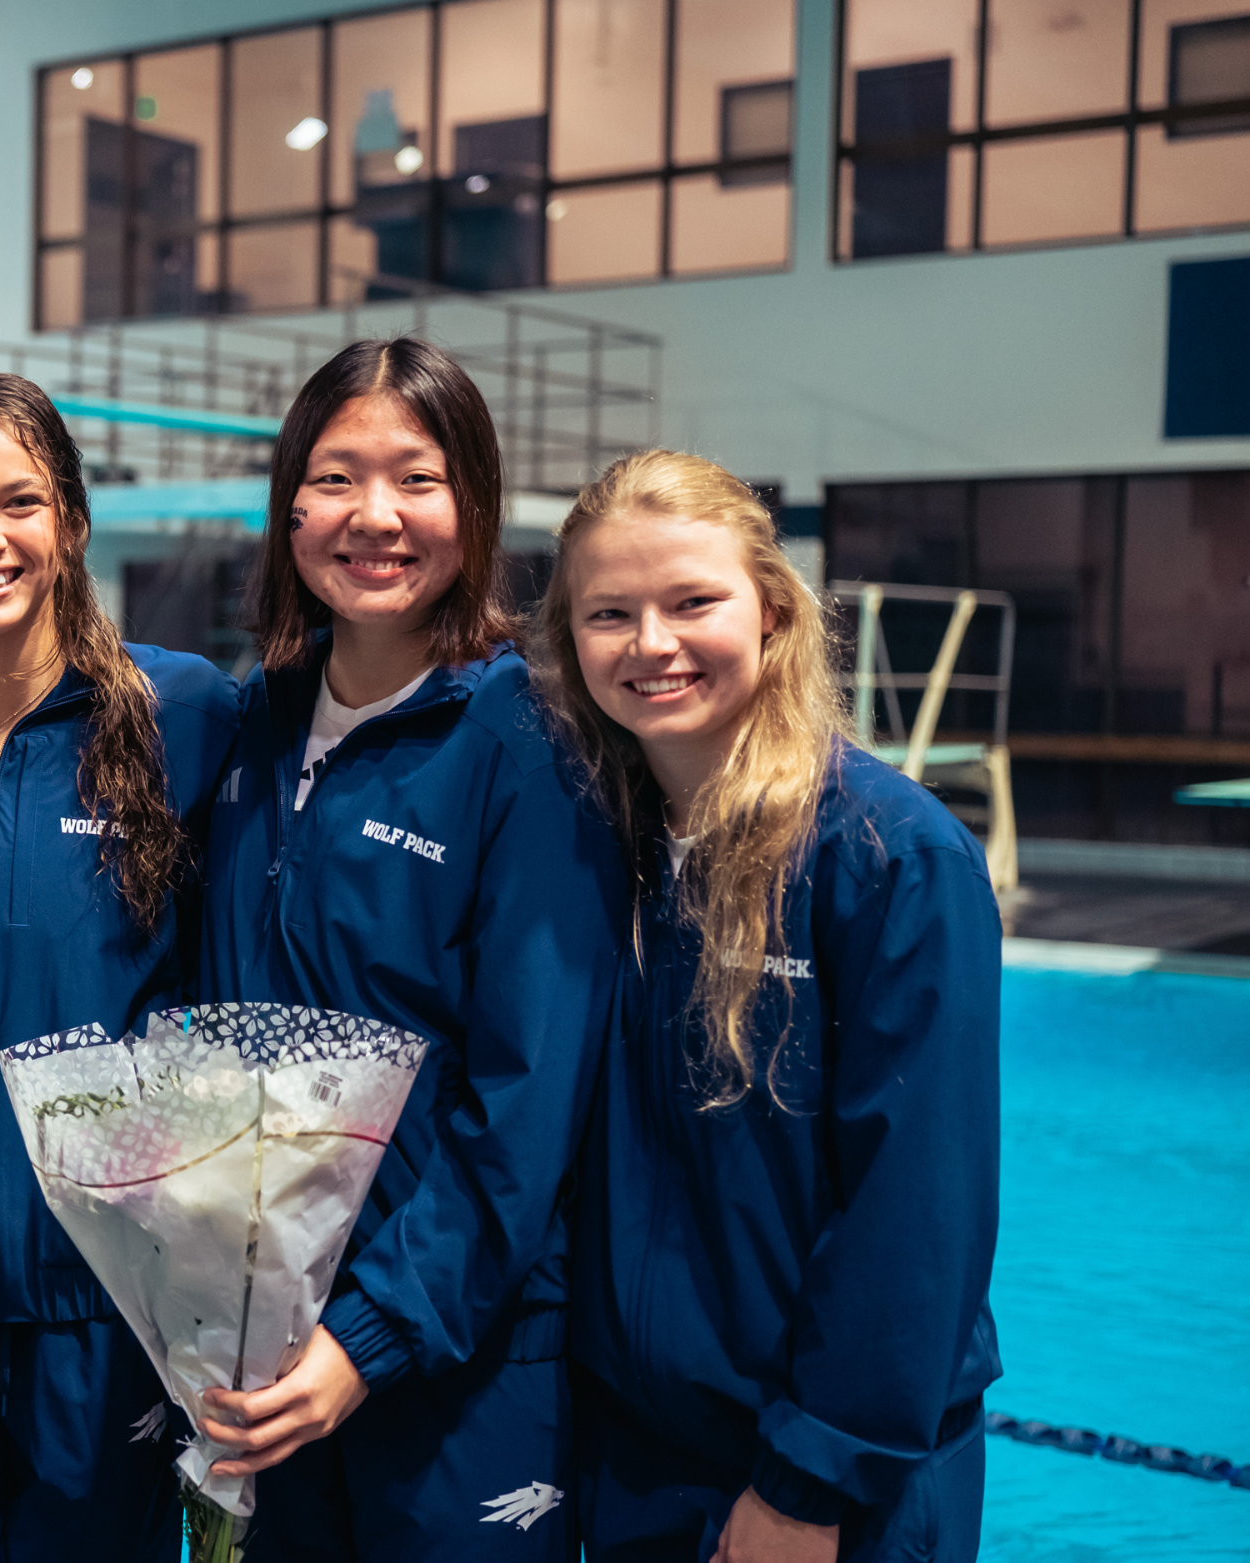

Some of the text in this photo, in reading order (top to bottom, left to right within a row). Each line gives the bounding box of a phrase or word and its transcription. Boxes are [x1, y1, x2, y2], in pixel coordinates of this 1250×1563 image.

[60, 817, 107, 835] WOLF
[362, 819, 446, 863] WOLF PACK
[763, 955, 811, 978] PACK
